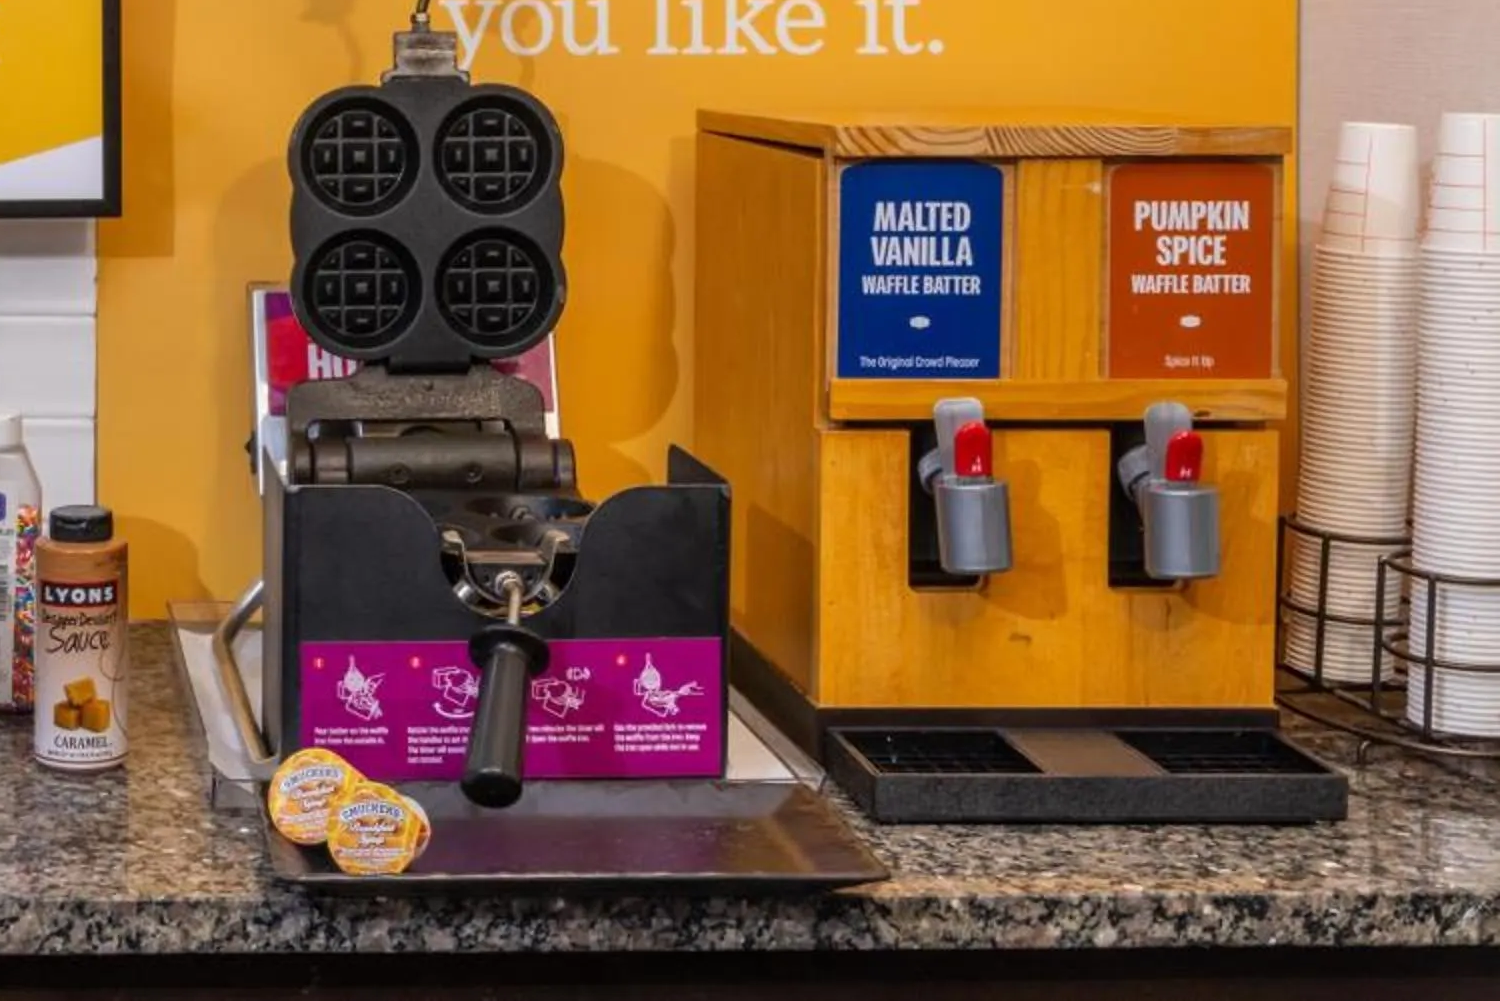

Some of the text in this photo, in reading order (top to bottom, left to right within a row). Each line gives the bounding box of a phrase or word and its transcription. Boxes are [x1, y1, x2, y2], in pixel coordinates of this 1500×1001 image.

[873, 200, 971, 232] MALTED
[1134, 200, 1250, 232] PUMPKIN
[869, 236, 973, 267] VANILLA
[1156, 235, 1226, 266] SPICE
[861, 274, 981, 295] WAFFLE BATTER
[1131, 274, 1251, 294] WAFFLE BATTER
[860, 356, 877, 368] The
[878, 355, 913, 370] Original
[45, 585, 114, 604] LYONS
[45, 623, 111, 654] Sauce
[54, 734, 107, 749] CARAMEL
